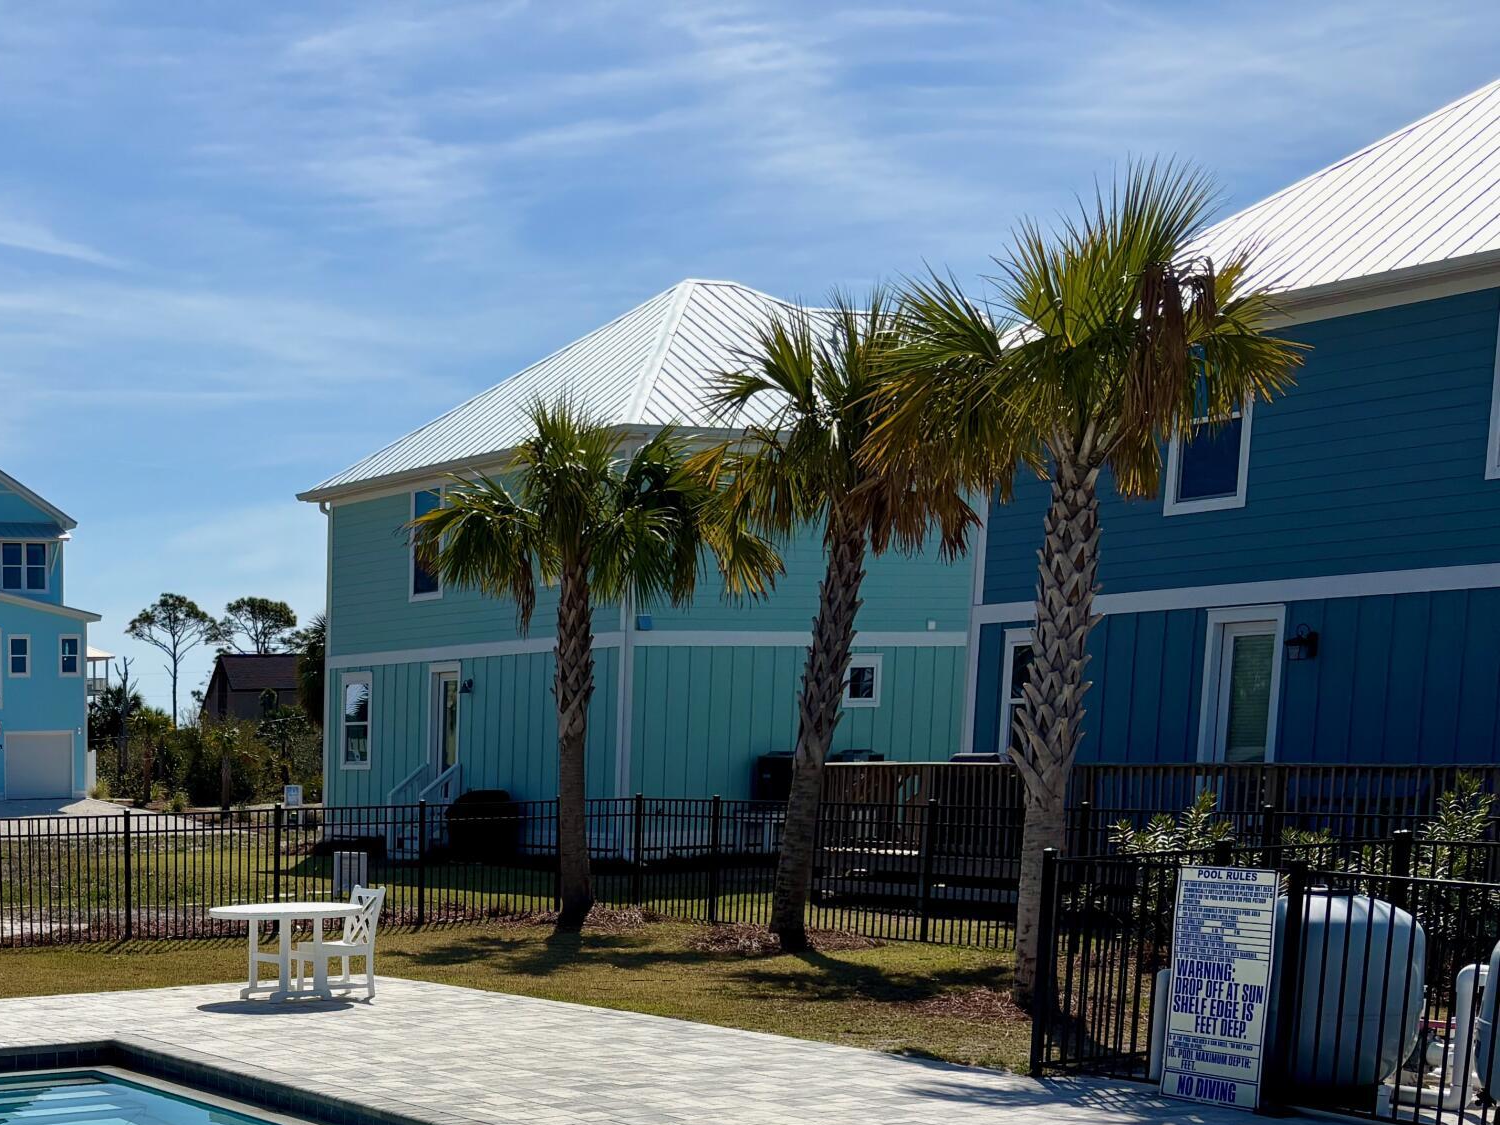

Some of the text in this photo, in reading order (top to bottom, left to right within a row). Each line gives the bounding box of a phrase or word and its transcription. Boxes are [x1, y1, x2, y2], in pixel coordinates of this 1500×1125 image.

[1197, 869, 1258, 881] POOL RULES
[1176, 958, 1236, 983] WARNING:
[1174, 976, 1264, 1004] DROP OFF AT SUN
[1173, 994, 1254, 1022] SHELF EDGE IS
[1194, 1015, 1247, 1040] FEET DEEP.
[1177, 1048, 1194, 1061] POOL
[1195, 1051, 1228, 1066] MAXIMUM
[1228, 1056, 1252, 1070] DEPTH:
[1180, 1060, 1197, 1071] FEET.
[1176, 1075, 1237, 1103] NO DIVING
